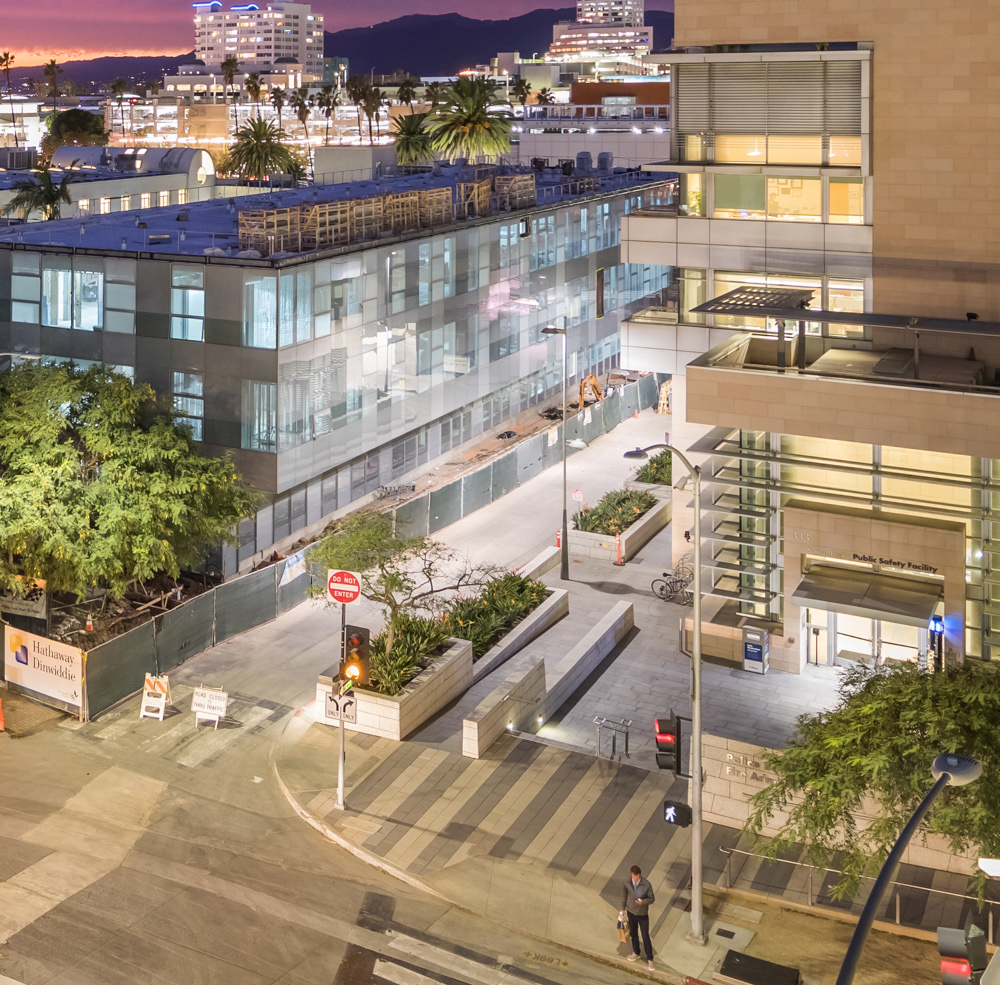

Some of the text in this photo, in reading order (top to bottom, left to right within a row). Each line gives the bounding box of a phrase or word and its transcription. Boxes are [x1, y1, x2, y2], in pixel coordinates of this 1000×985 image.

[853, 554, 878, 564] Public
[879, 558, 906, 568] Safety
[908, 562, 938, 573] Facility
[33, 640, 74, 667] Hathaway
[33, 657, 76, 682] Dinwiddie
[726, 754, 760, 768] Police
[726, 766, 746, 776] Fire
